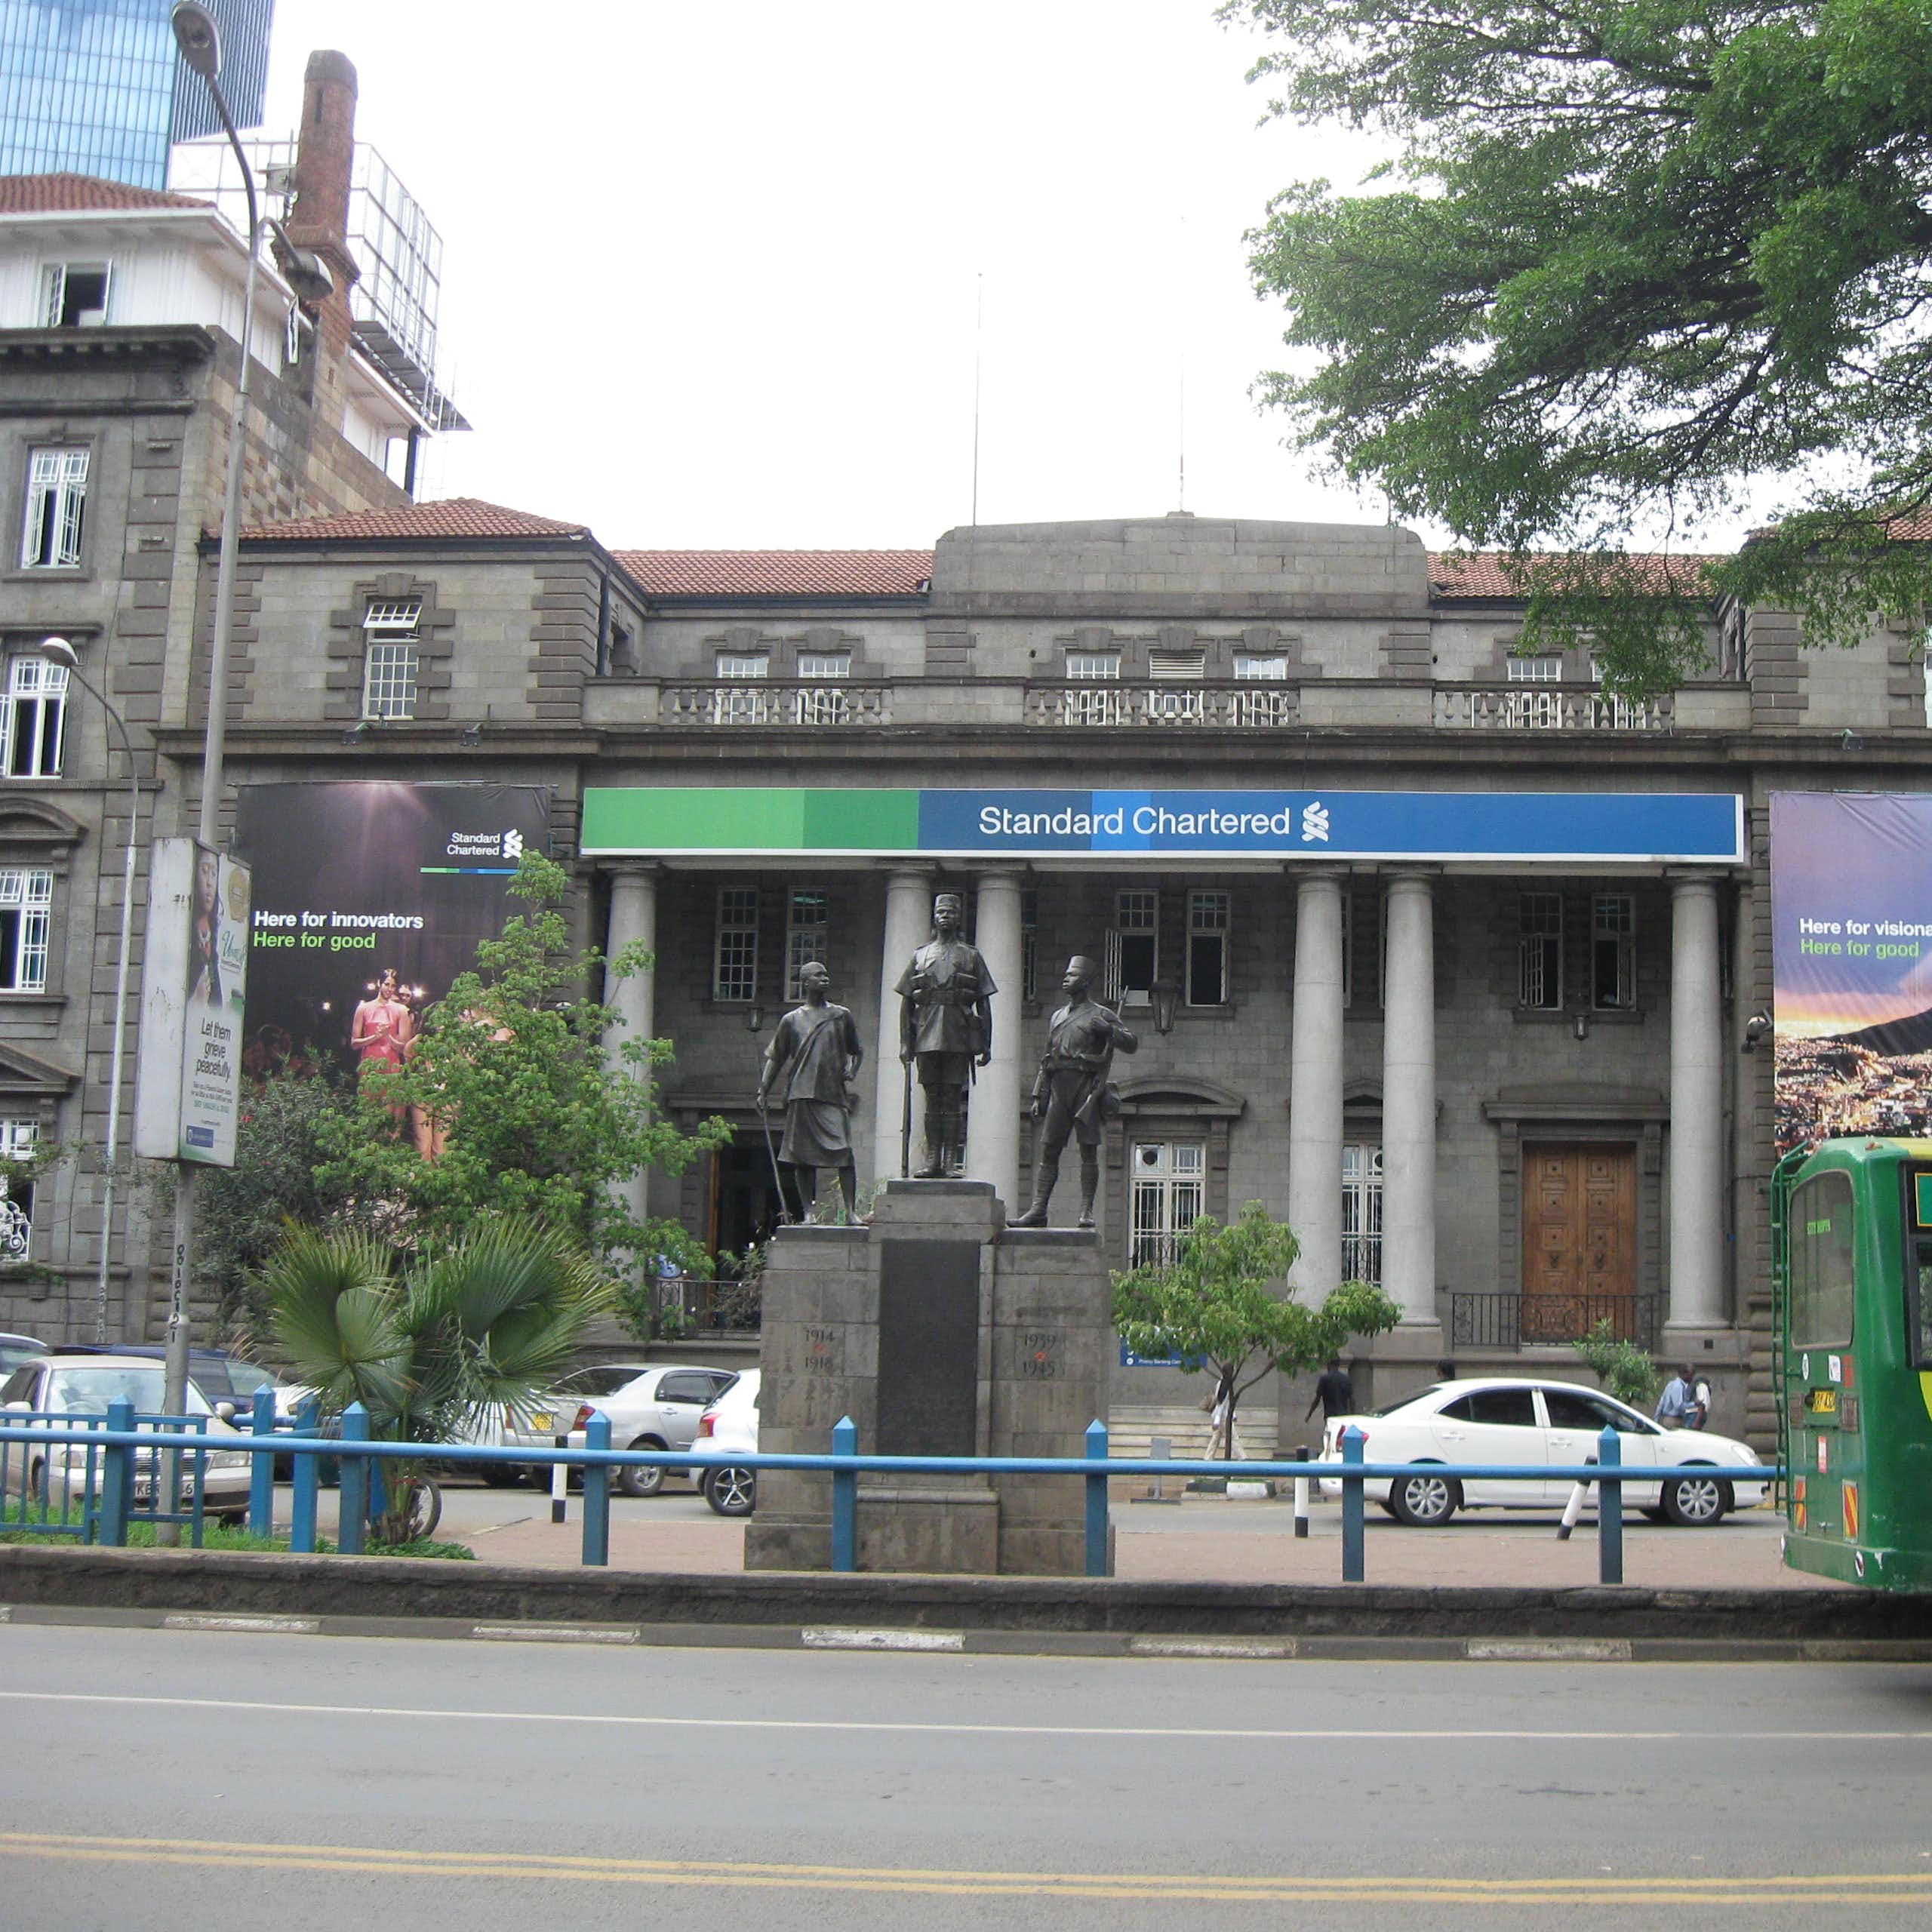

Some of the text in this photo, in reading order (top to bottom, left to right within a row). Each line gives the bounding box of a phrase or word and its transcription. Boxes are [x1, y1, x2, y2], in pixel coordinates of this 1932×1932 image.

[979, 807, 1291, 835] Standard Chartered
[451, 832, 500, 843] Standard
[447, 844, 500, 855] Chartered
[254, 911, 424, 929] Here for innovators
[1799, 918, 1841, 934] Here
[1846, 920, 1871, 936] for
[253, 931, 296, 947] Here
[300, 931, 327, 948] for
[330, 932, 376, 952] good
[1800, 939, 1920, 959] Here for good
[201, 1017, 231, 1041] Let them
[205, 1042, 226, 1059] grieve
[804, 1328, 835, 1343] 1914
